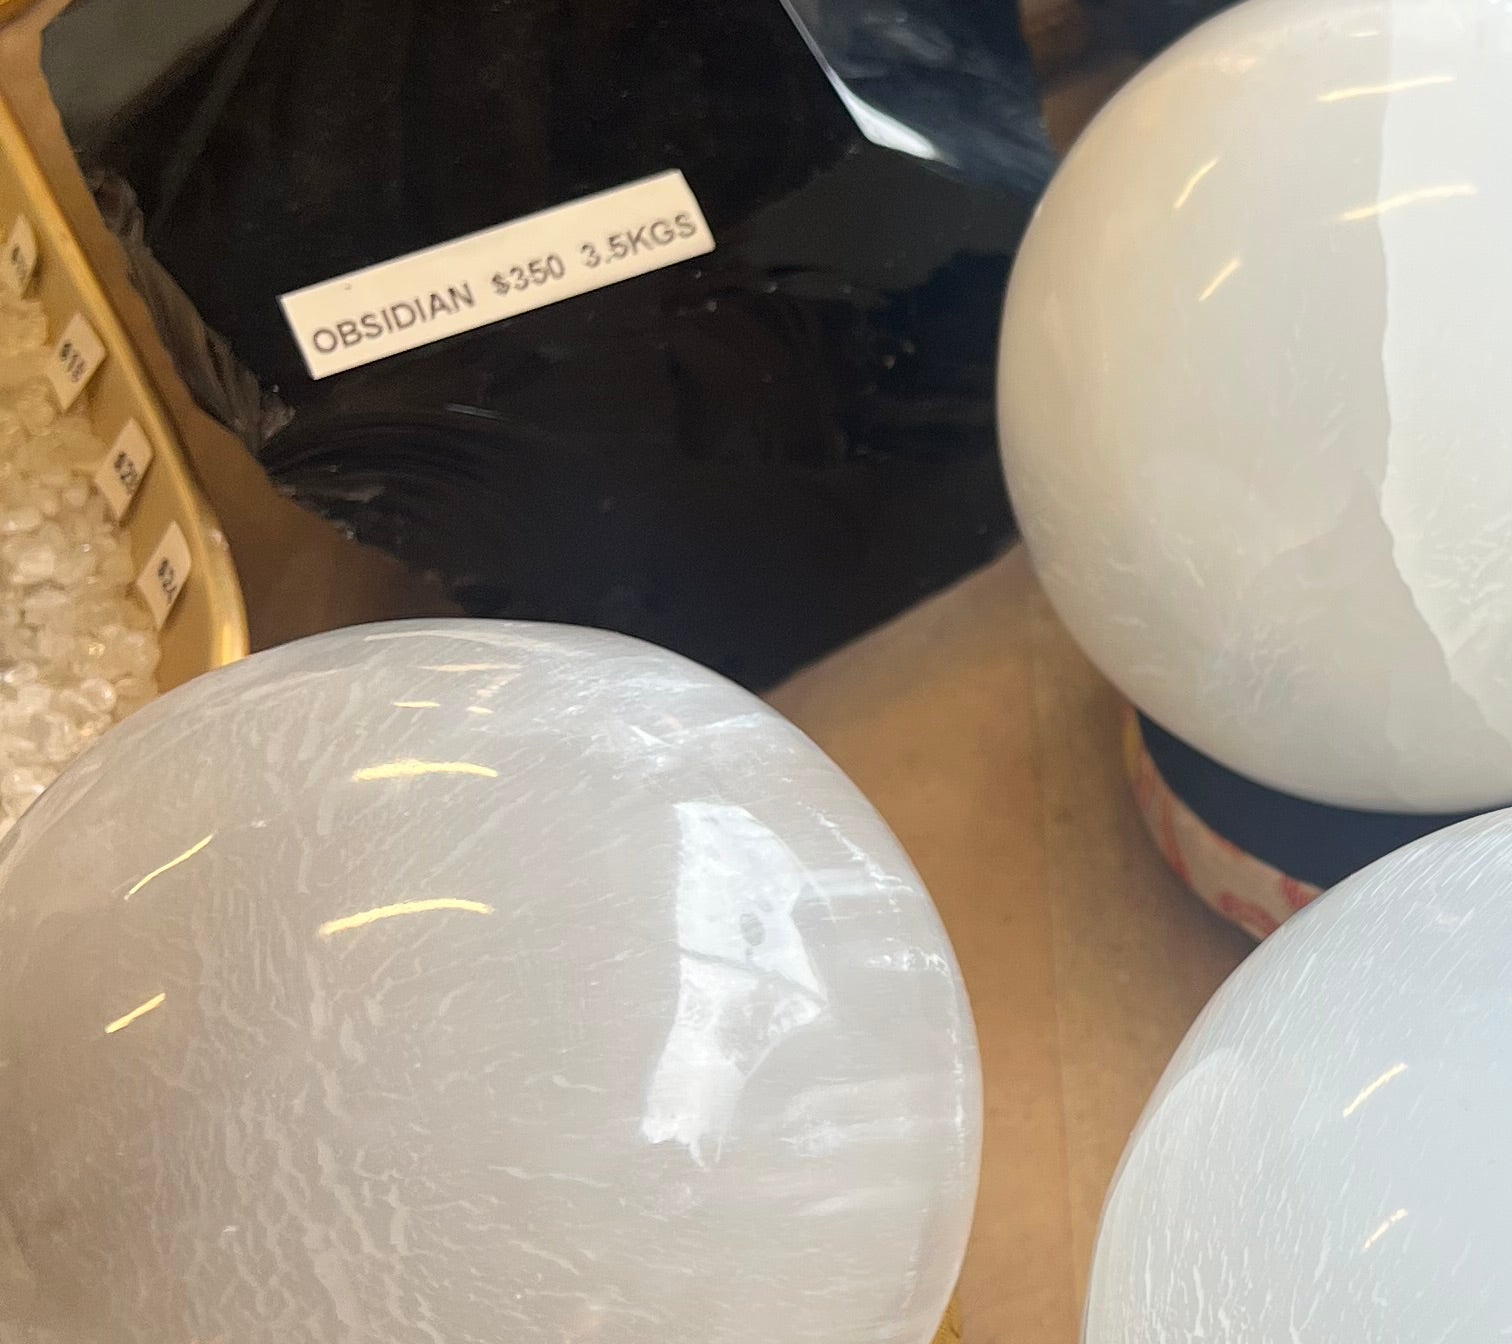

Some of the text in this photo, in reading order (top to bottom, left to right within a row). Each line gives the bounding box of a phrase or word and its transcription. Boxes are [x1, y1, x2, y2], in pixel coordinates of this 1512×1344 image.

[312, 212, 698, 356] OBSIDIAN $350 3.5KGS
